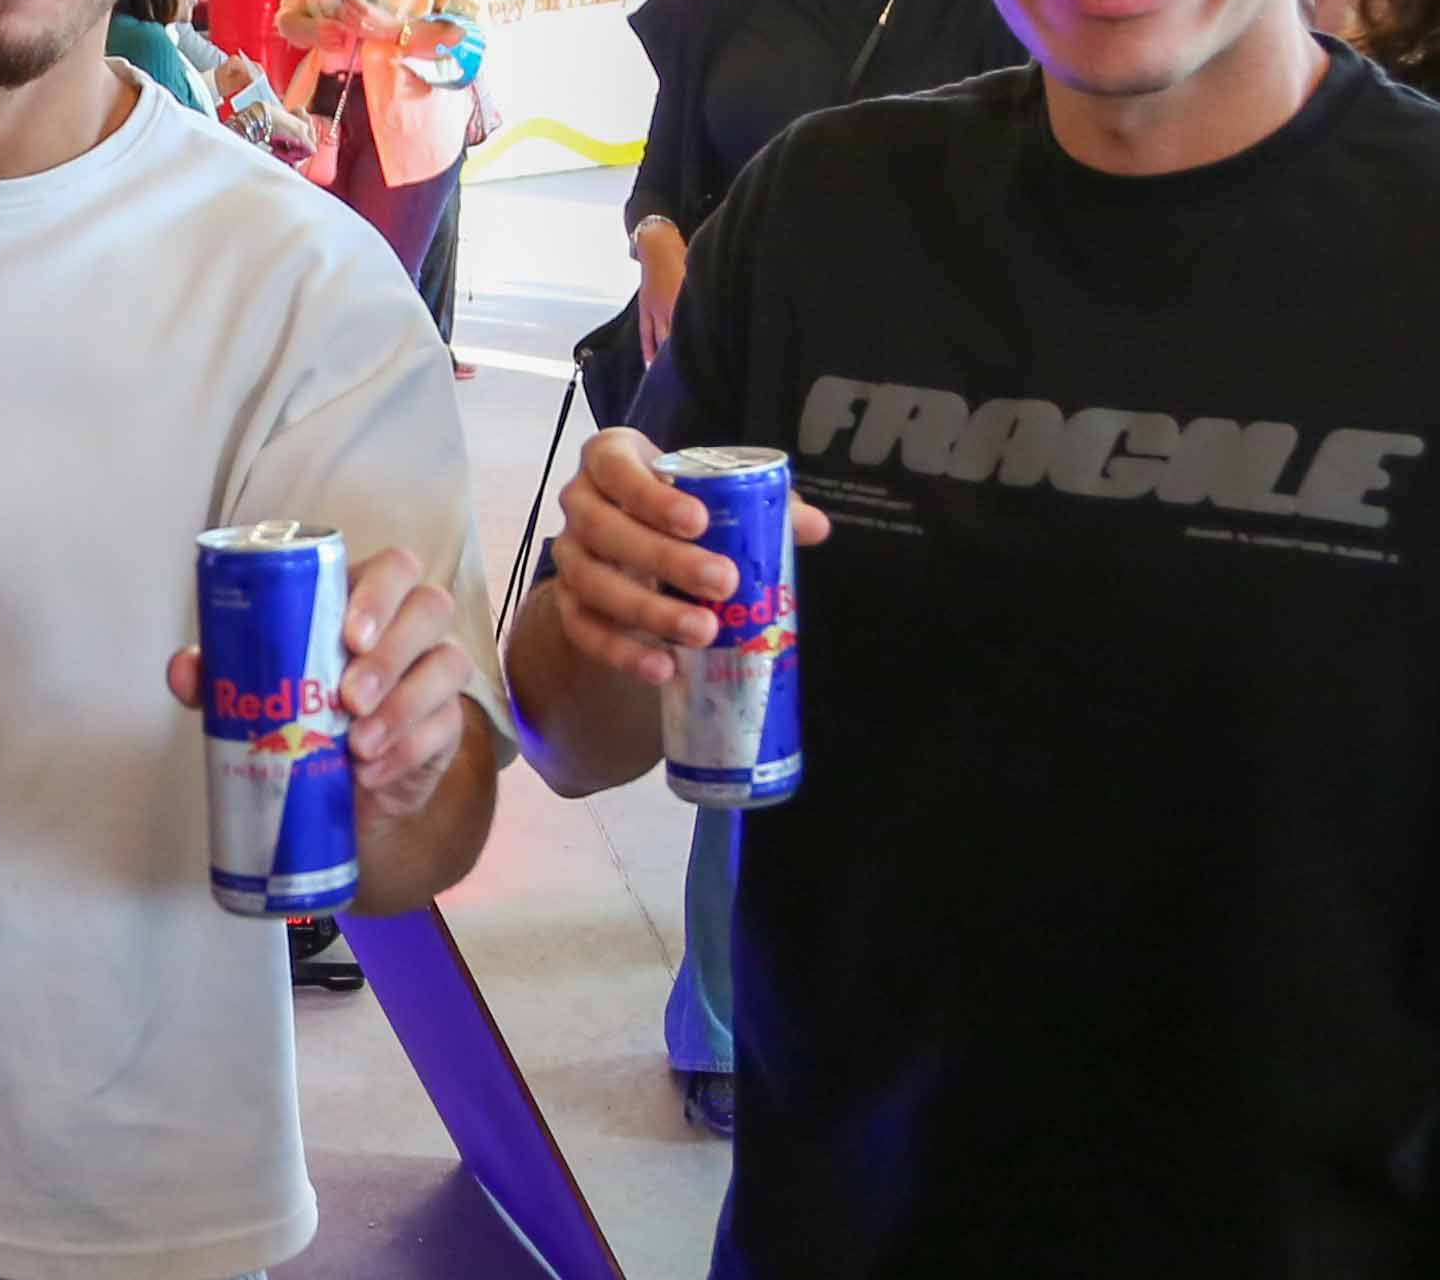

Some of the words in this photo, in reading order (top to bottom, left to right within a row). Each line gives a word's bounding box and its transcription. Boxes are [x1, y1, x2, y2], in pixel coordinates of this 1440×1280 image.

[795, 374, 1426, 529] FRAGILE
[213, 677, 293, 720] Red
[298, 679, 342, 716] Bu
